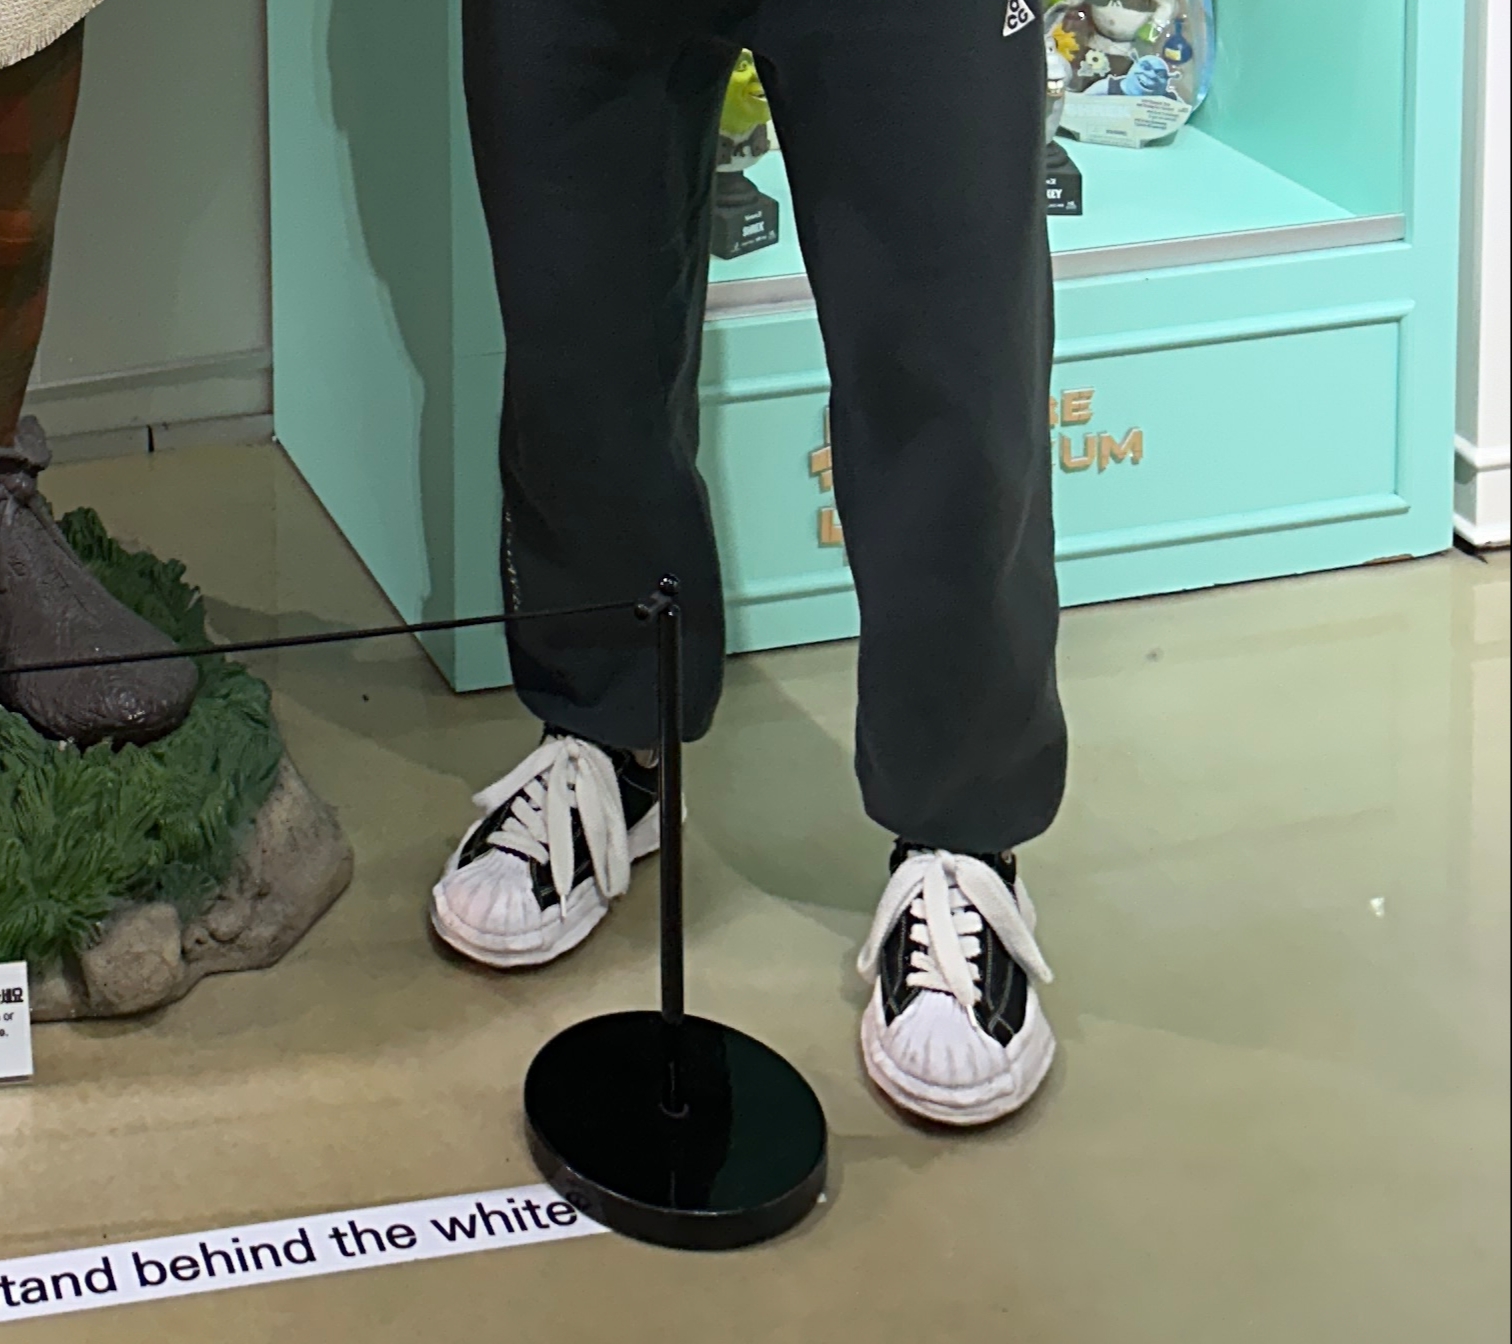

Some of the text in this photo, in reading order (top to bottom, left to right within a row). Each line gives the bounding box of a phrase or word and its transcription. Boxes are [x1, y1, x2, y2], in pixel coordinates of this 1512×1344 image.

[3, 1011, 15, 1022] or
[132, 1227, 317, 1287] behind
[329, 1221, 417, 1257] the
[430, 1197, 578, 1242] white
